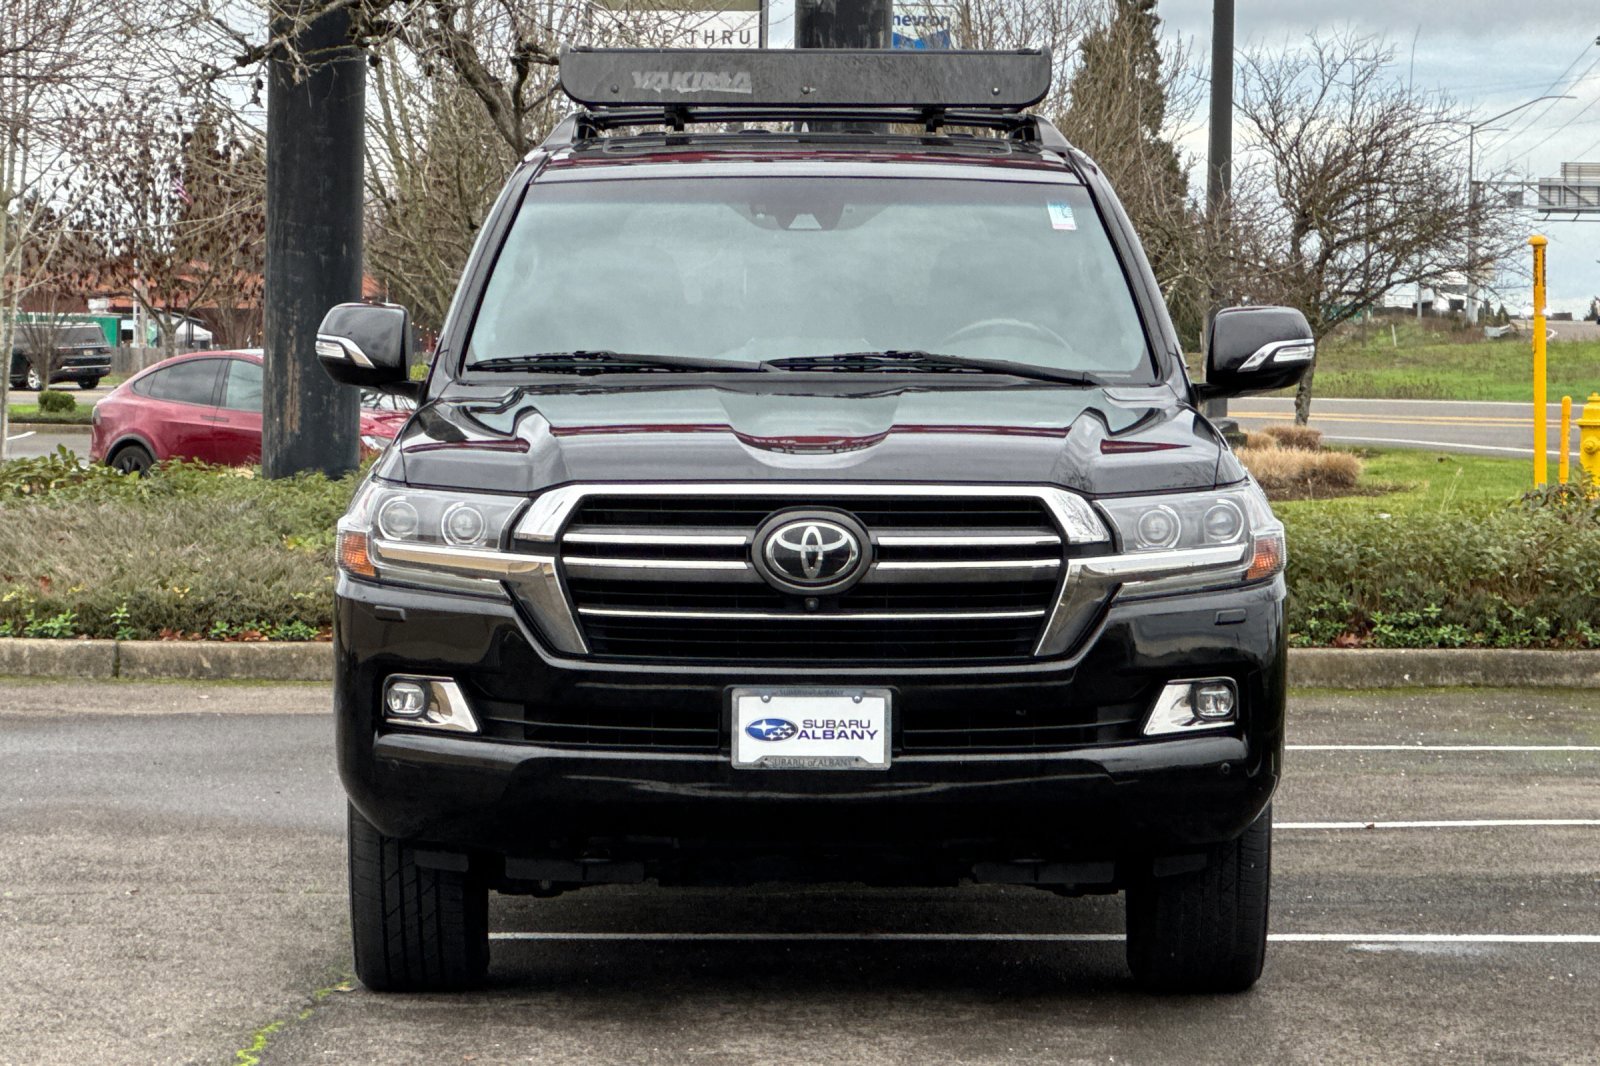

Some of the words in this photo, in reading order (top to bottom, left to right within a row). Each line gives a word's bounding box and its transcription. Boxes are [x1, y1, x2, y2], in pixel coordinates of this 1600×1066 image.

[690, 29, 751, 44] THRU
[631, 71, 752, 91] YAKIMA
[802, 719, 871, 729] SUBARU
[797, 729, 878, 740] ALBANY
